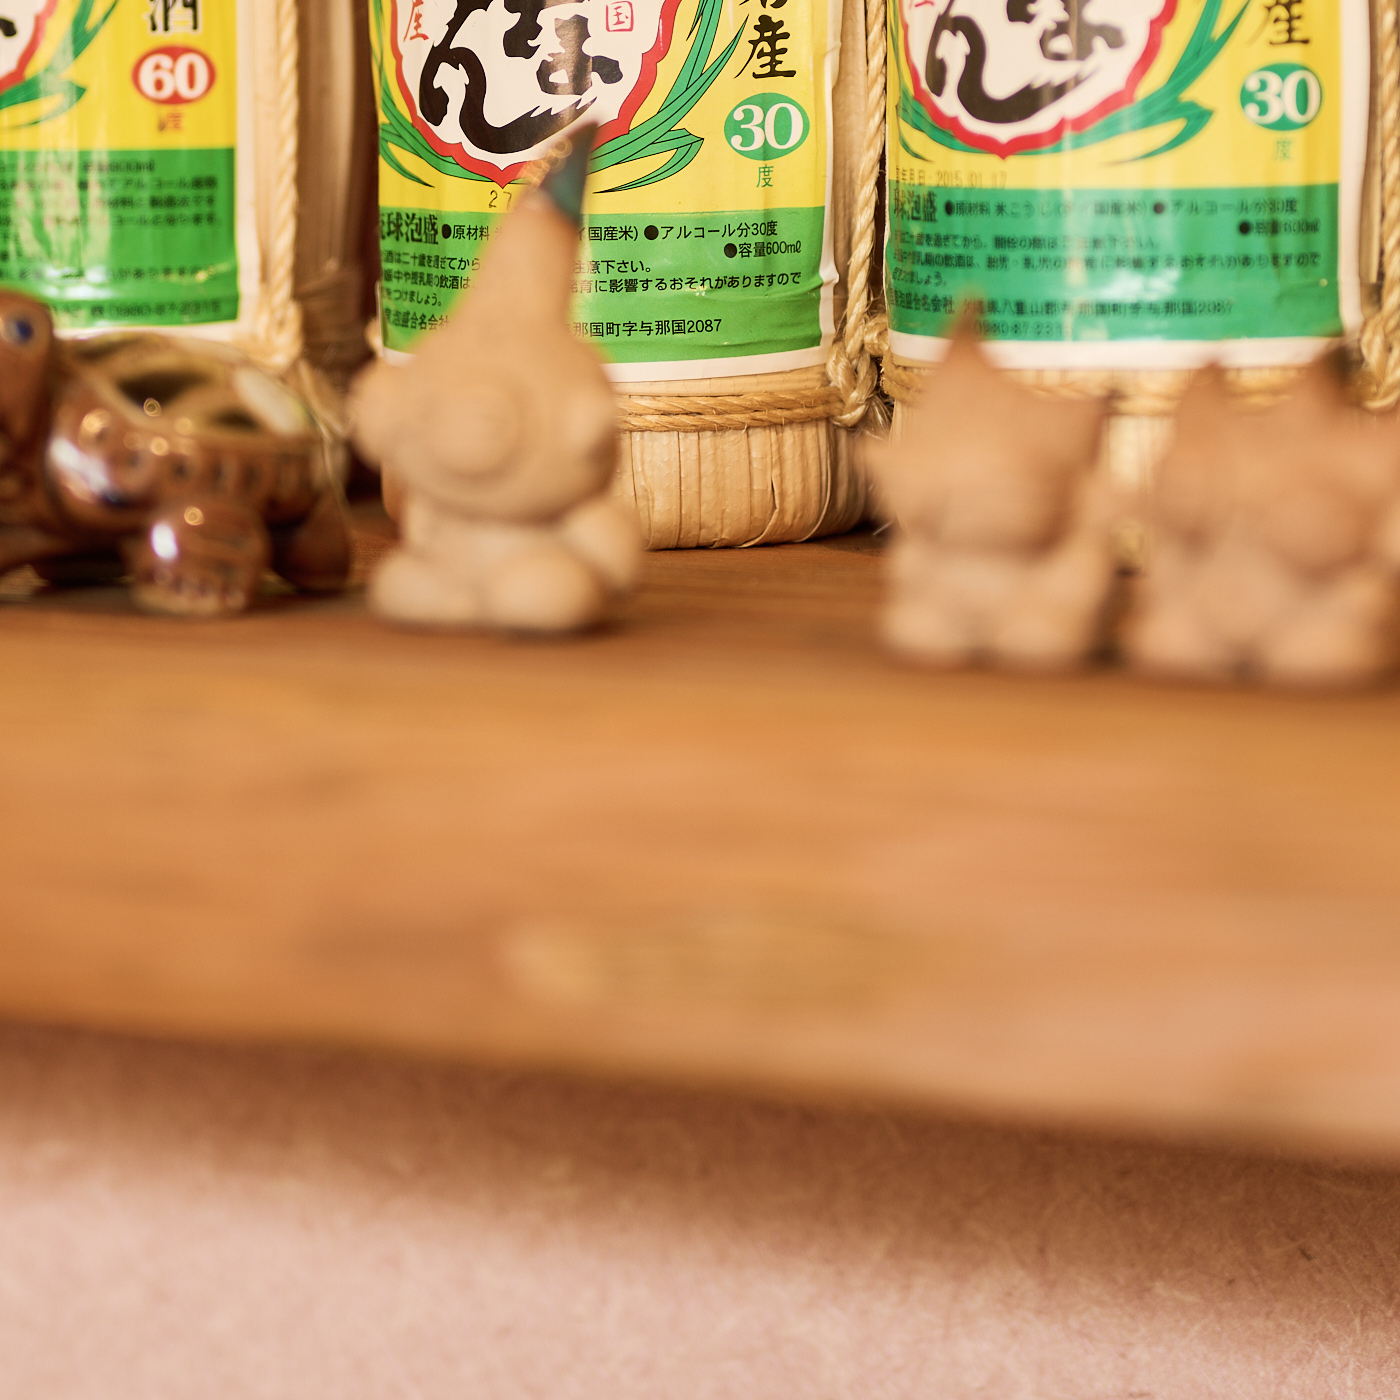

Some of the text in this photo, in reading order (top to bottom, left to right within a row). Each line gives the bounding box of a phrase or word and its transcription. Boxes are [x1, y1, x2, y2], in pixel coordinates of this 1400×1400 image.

[138, 52, 210, 102] 60
[1244, 70, 1320, 126] 30
[731, 101, 807, 153] 30
[755, 162, 776, 190] 度
[452, 223, 490, 242] 原材料
[660, 220, 779, 242] アルコール分30度
